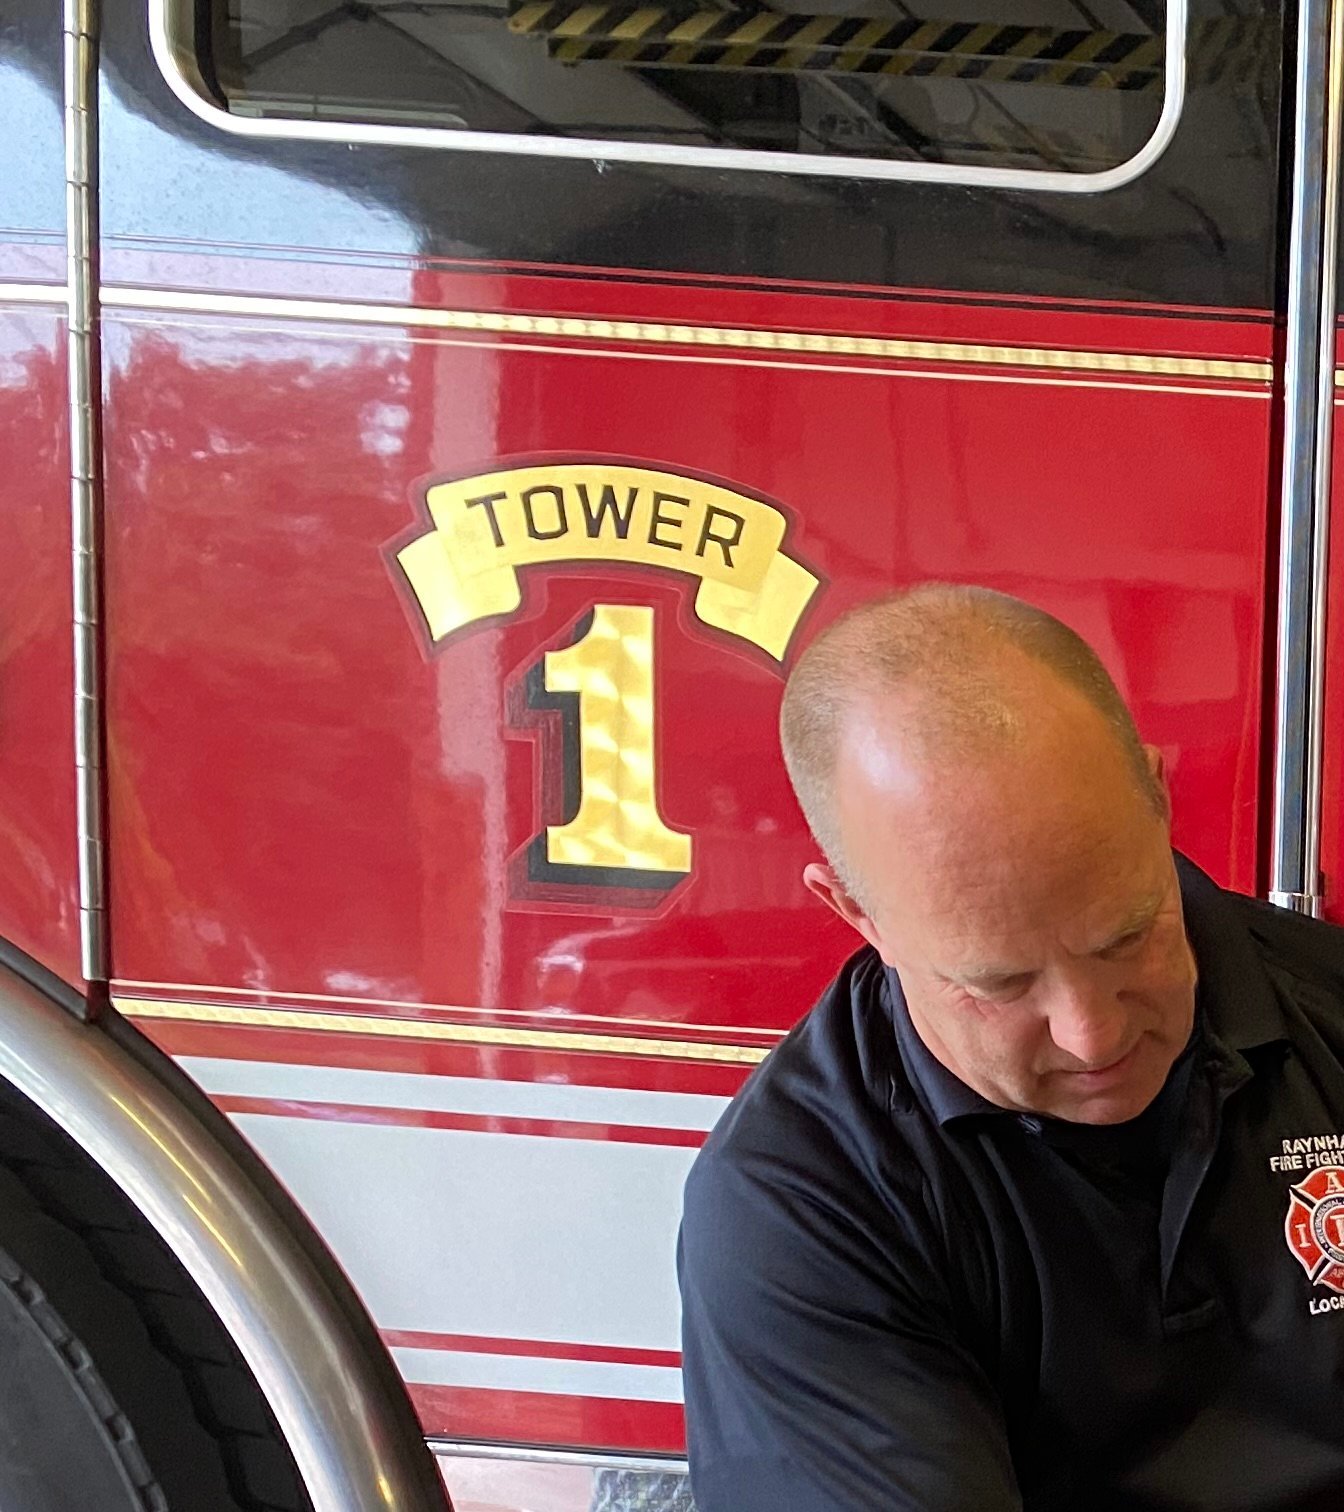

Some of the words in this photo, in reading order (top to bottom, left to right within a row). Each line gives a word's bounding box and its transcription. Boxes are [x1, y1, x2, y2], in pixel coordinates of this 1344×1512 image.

[464, 482, 748, 570] TOWER
[540, 604, 693, 873] 1
[1269, 1154, 1304, 1173] FIRE
[1294, 1223, 1312, 1248] I
